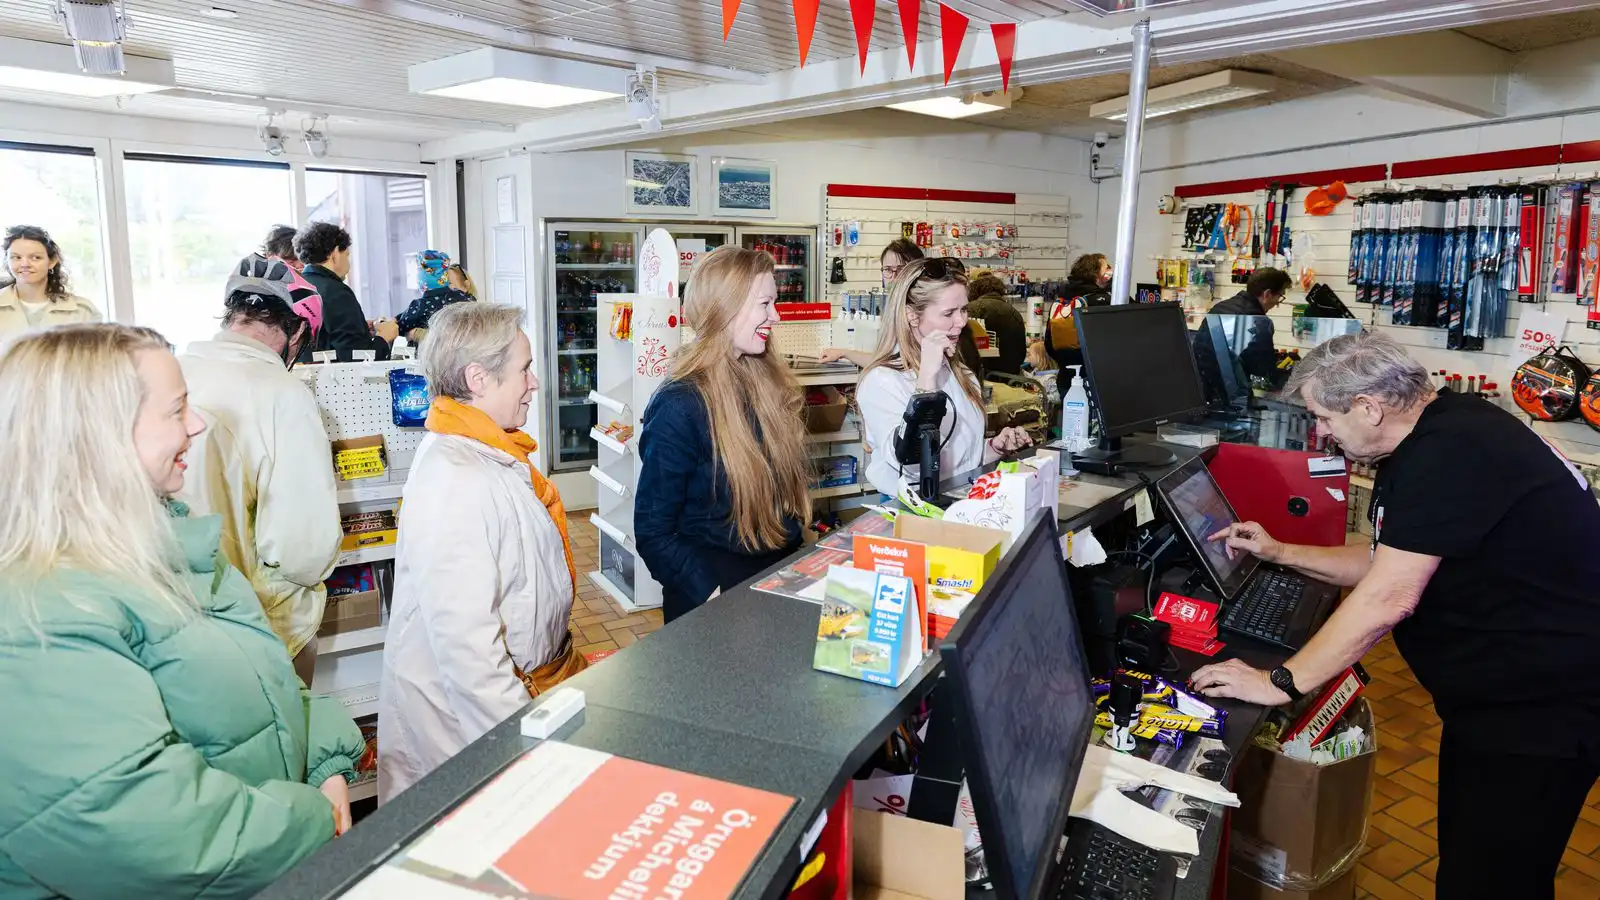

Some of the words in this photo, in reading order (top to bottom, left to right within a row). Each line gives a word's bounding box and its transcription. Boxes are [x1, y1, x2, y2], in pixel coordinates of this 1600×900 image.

[1522, 329, 1556, 347] 50%
[936, 577, 973, 588] Smash!
[689, 799, 715, 814] á
[583, 791, 679, 880] dekkjum
[654, 808, 758, 900] Öruggar
